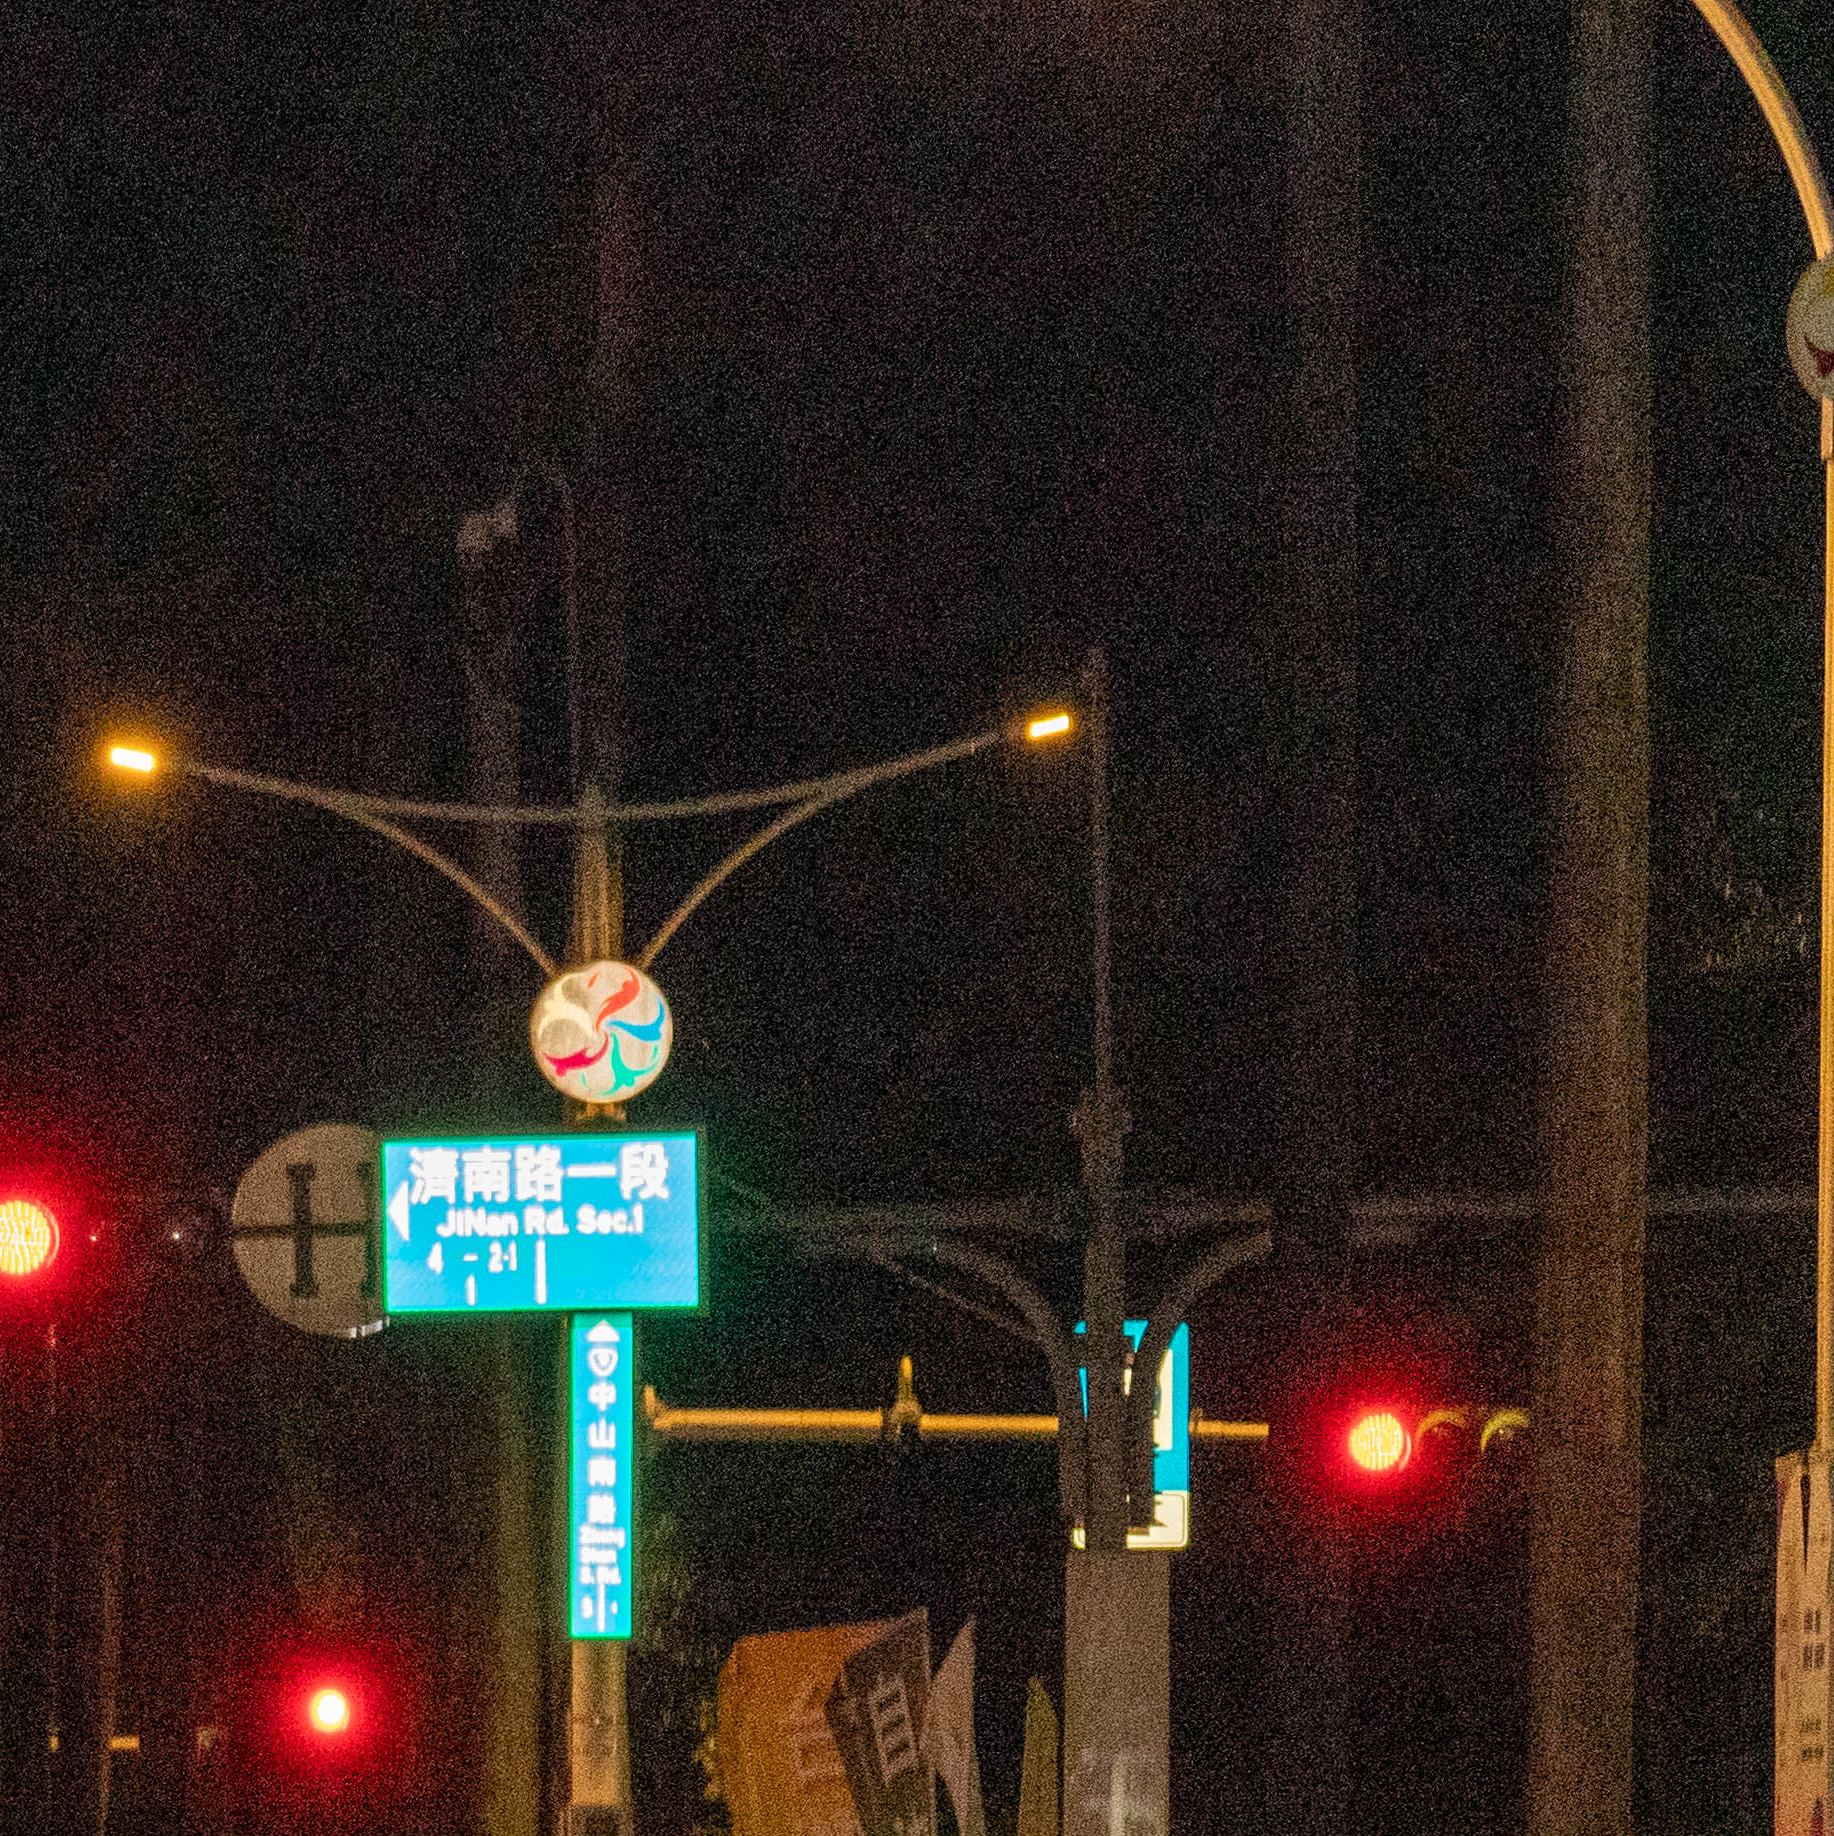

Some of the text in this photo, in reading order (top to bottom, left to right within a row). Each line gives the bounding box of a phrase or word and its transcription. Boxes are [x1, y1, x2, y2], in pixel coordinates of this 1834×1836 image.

[408, 1142, 670, 1203] 濟南路一段
[524, 1204, 570, 1235] Rd.
[576, 1202, 644, 1235] Sec.1
